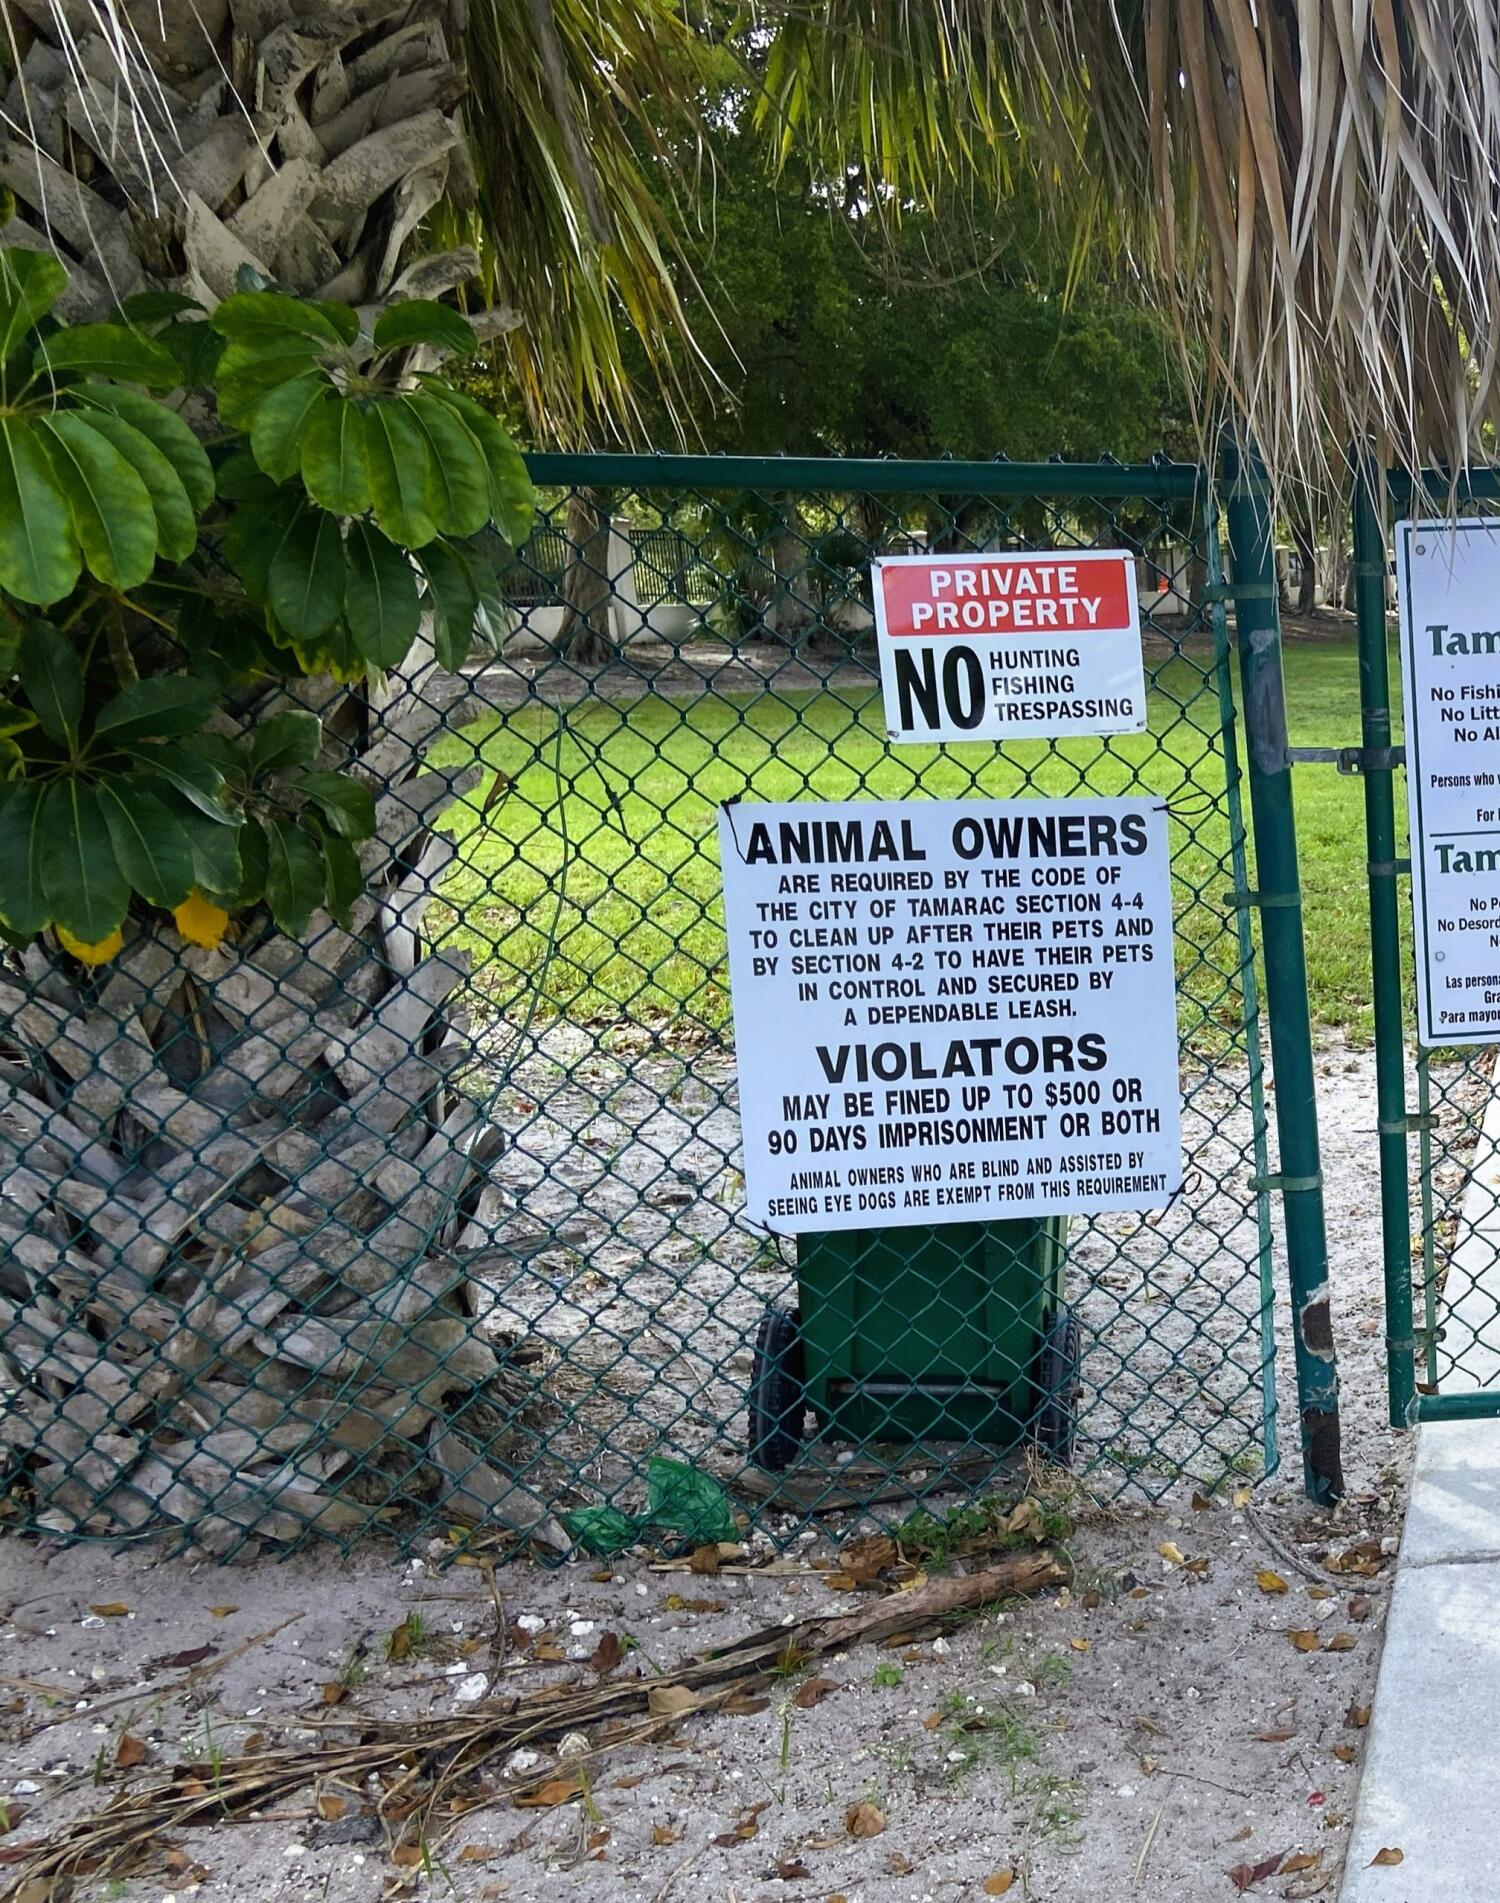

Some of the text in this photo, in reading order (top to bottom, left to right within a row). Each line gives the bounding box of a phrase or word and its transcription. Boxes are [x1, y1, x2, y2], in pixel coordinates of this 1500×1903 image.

[930, 567, 1078, 597] PRIVATE
[911, 597, 1102, 630] PROPERTY
[989, 648, 1080, 670] HUNTING
[894, 645, 985, 731] NO
[992, 675, 1074, 696] FISHING
[994, 698, 1133, 721] TRESPASSING
[1430, 774, 1471, 788] Persons
[1473, 772, 1495, 786] who
[1476, 808, 1495, 822] For
[746, 813, 1148, 865] ANIMAL OWNERS
[778, 866, 1121, 894] ARE REQUIRED BY THE CODE OF
[756, 892, 1144, 922] THE CITY OF TAMARAC SECTION 4-4
[749, 917, 1154, 949] TO CLEAN UP AFTER THEIR PETS AND
[752, 943, 1153, 976] BY SECTION 4-2 TO HAVE THEIR PETS
[798, 970, 1114, 1002] IN CONTROL AND SECURED BY
[844, 998, 1077, 1027] A DEPENDABLE LEASH.
[816, 1033, 1108, 1084] VIOLATORS
[782, 1077, 1143, 1122] MAY BE FINED UP TO $500 OR
[768, 1108, 1160, 1155] 90 DAYS IMPRISONMENT OR BOTH
[790, 1151, 1144, 1190] ANIMAL OWNERS WHO ARE BLIND AND ASSISTED BY
[768, 1174, 1167, 1217] SEEING EYE DOGS ARE EXEMPT FROM THIS REQUIREMENT
